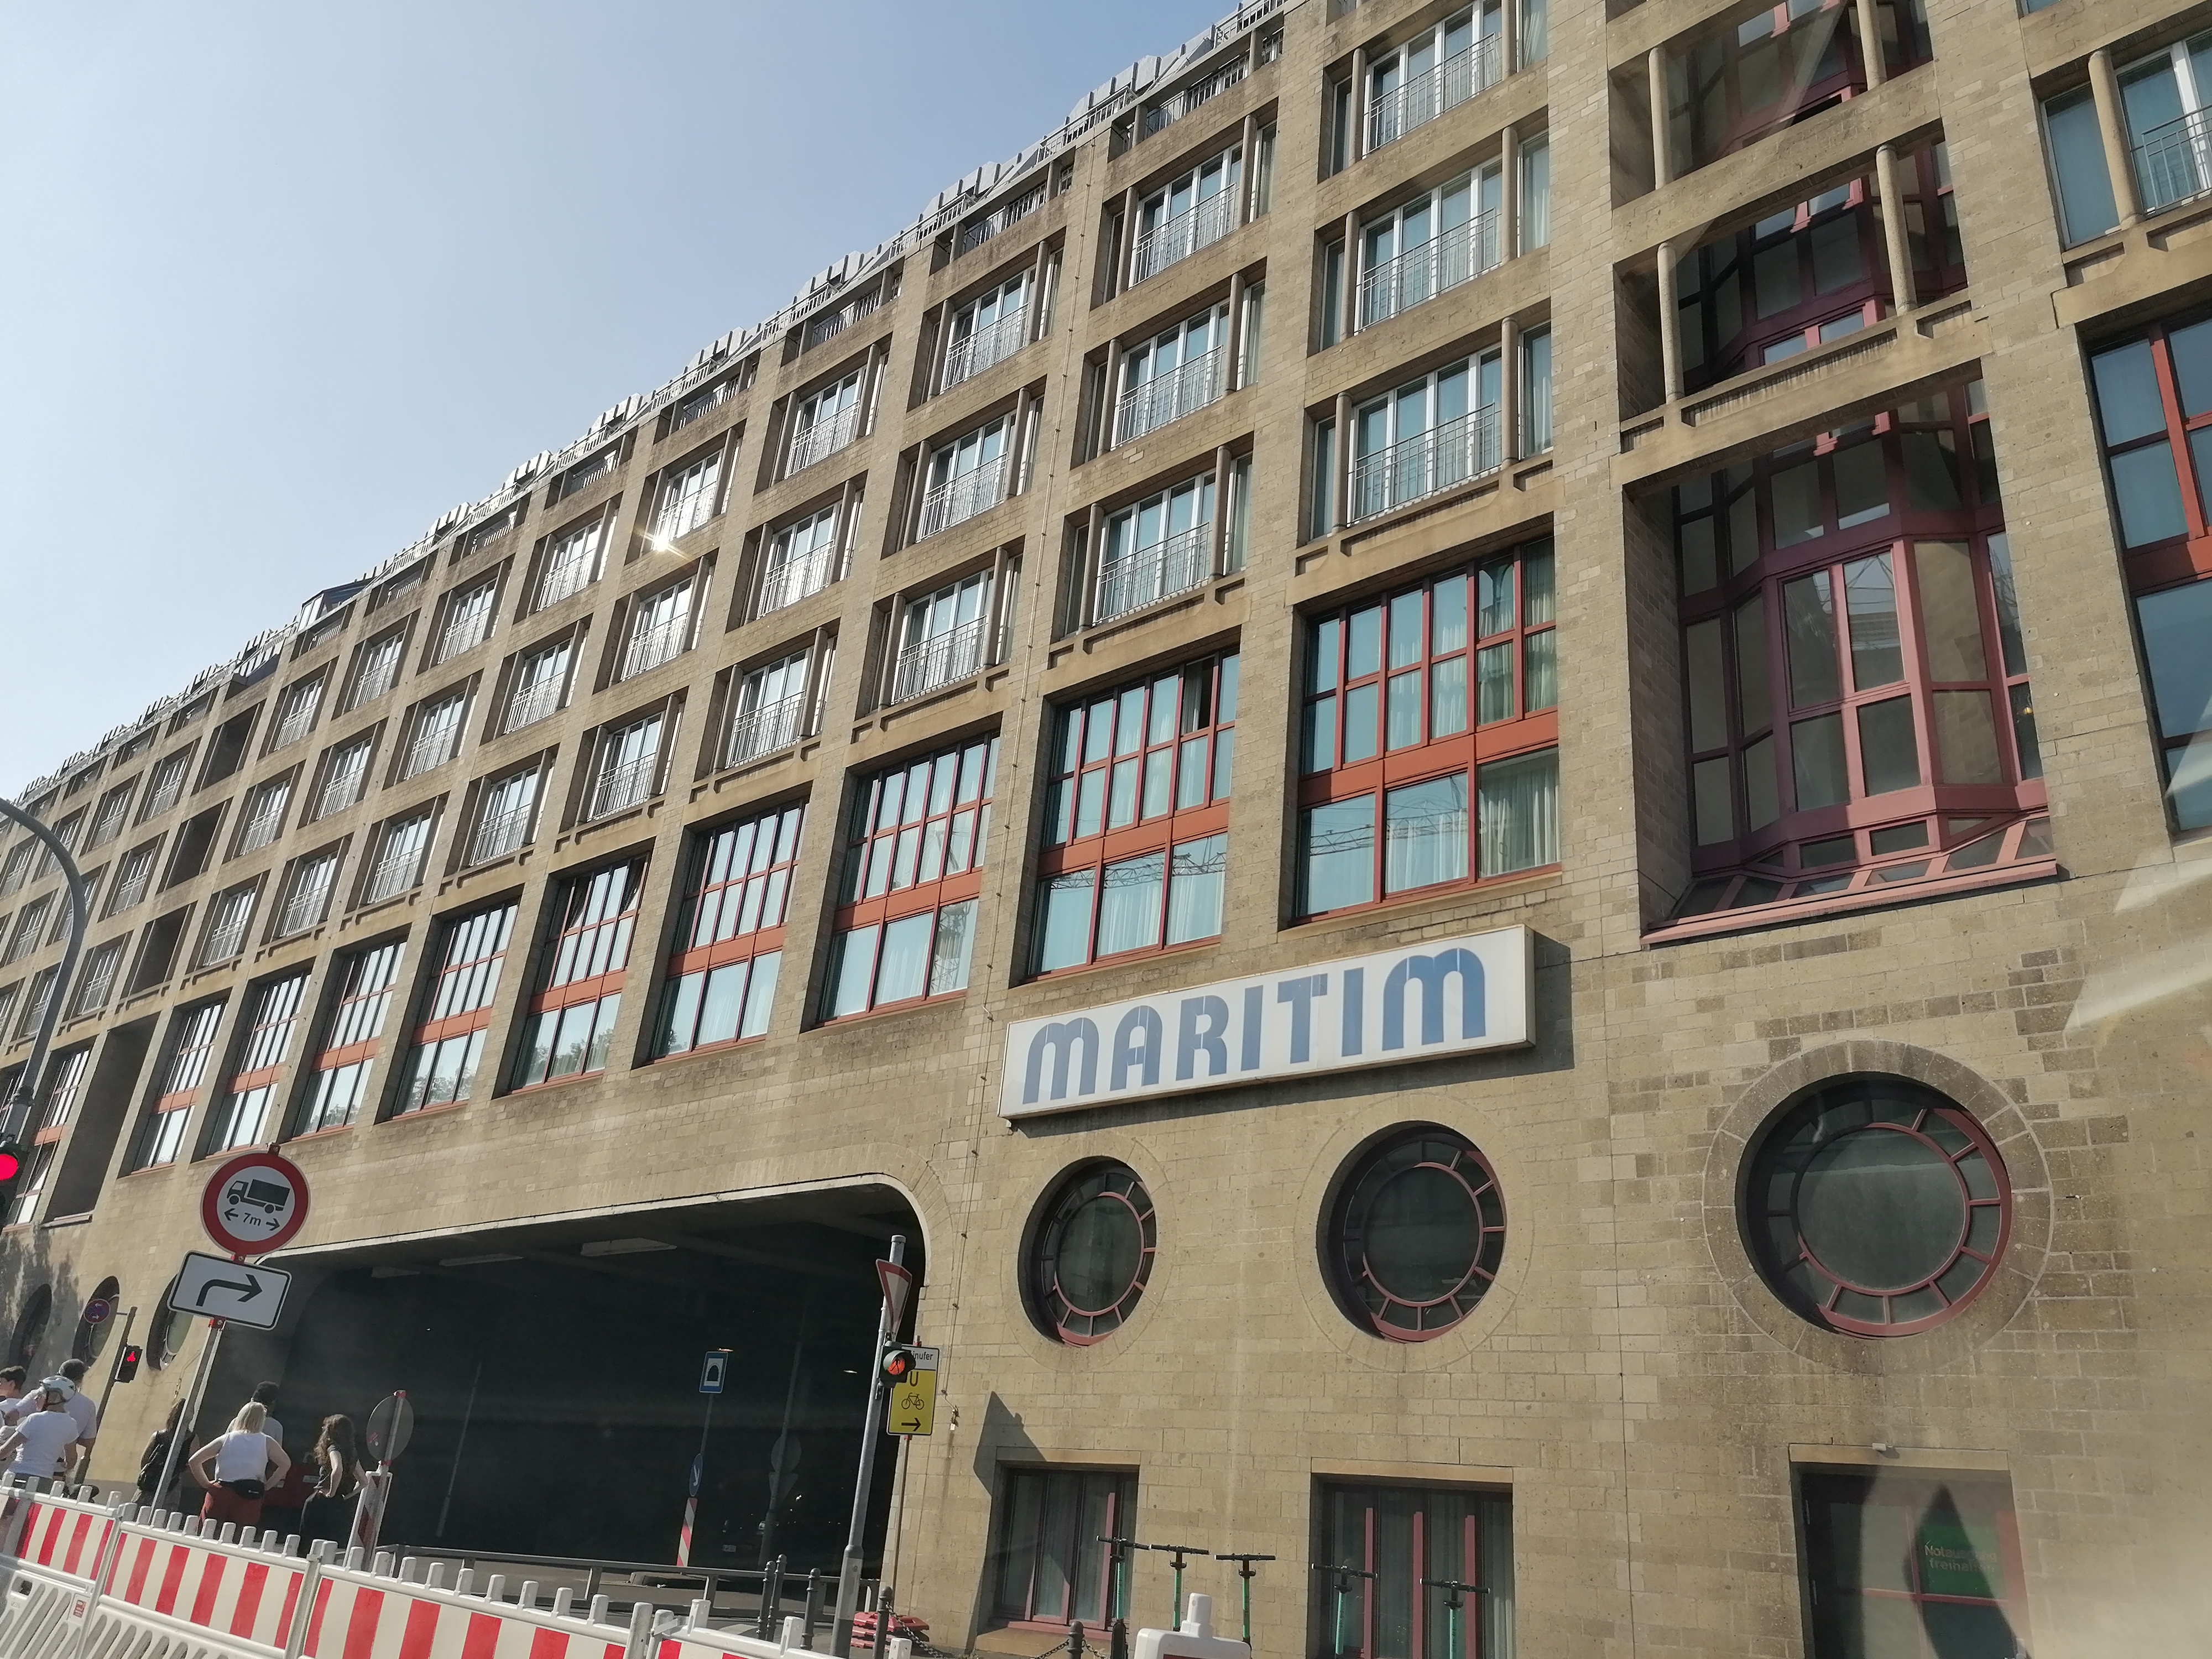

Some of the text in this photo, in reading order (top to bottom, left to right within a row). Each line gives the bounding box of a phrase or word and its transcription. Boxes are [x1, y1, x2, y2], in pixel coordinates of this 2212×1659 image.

[1022, 947, 1486, 1104] MARITIM
[243, 1212, 261, 1226] 7m
[912, 1350, 933, 1360] inufer
[910, 1371, 919, 1387] U
